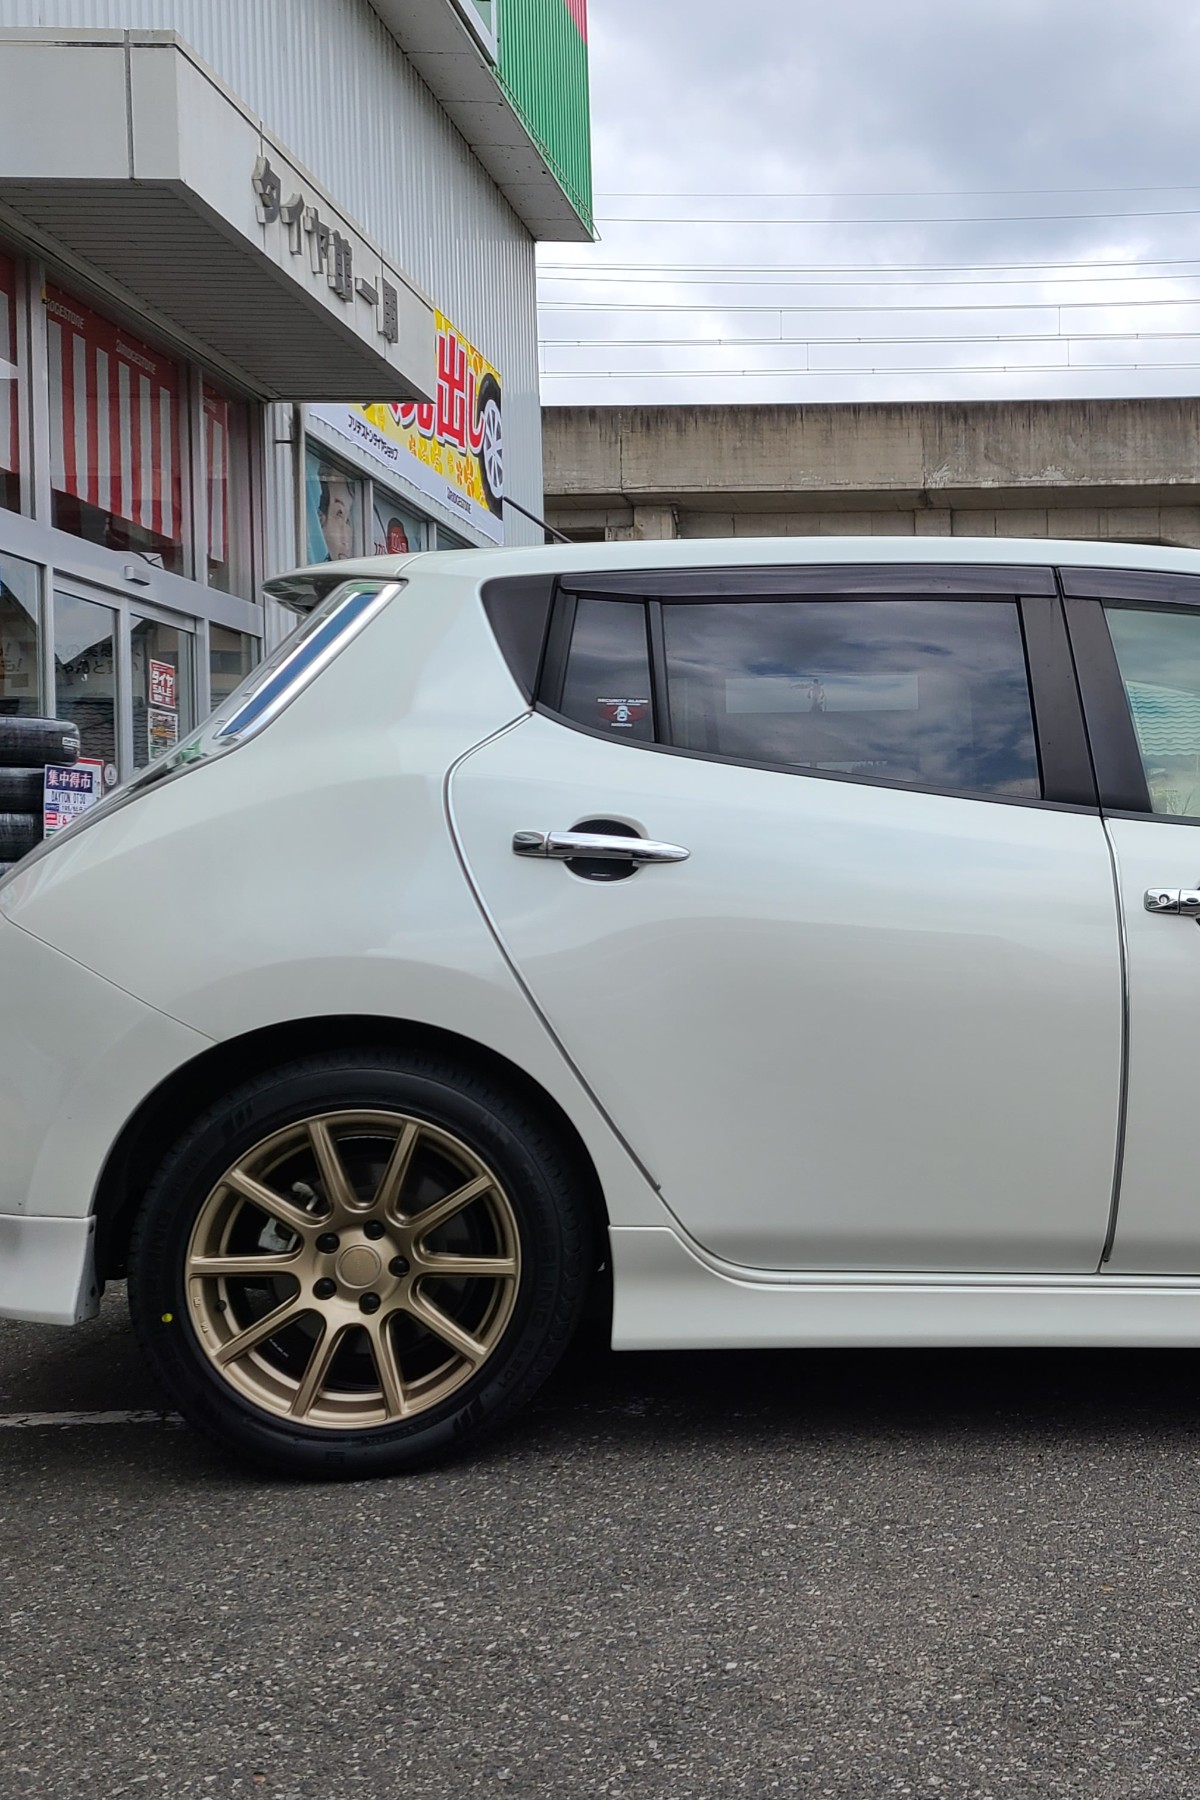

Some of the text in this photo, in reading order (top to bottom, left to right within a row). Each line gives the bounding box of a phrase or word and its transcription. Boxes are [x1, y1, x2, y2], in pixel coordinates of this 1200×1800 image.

[251, 155, 398, 343] タイヤ館一関
[152, 684, 172, 697] SALE
[47, 769, 93, 789] 集中得市
